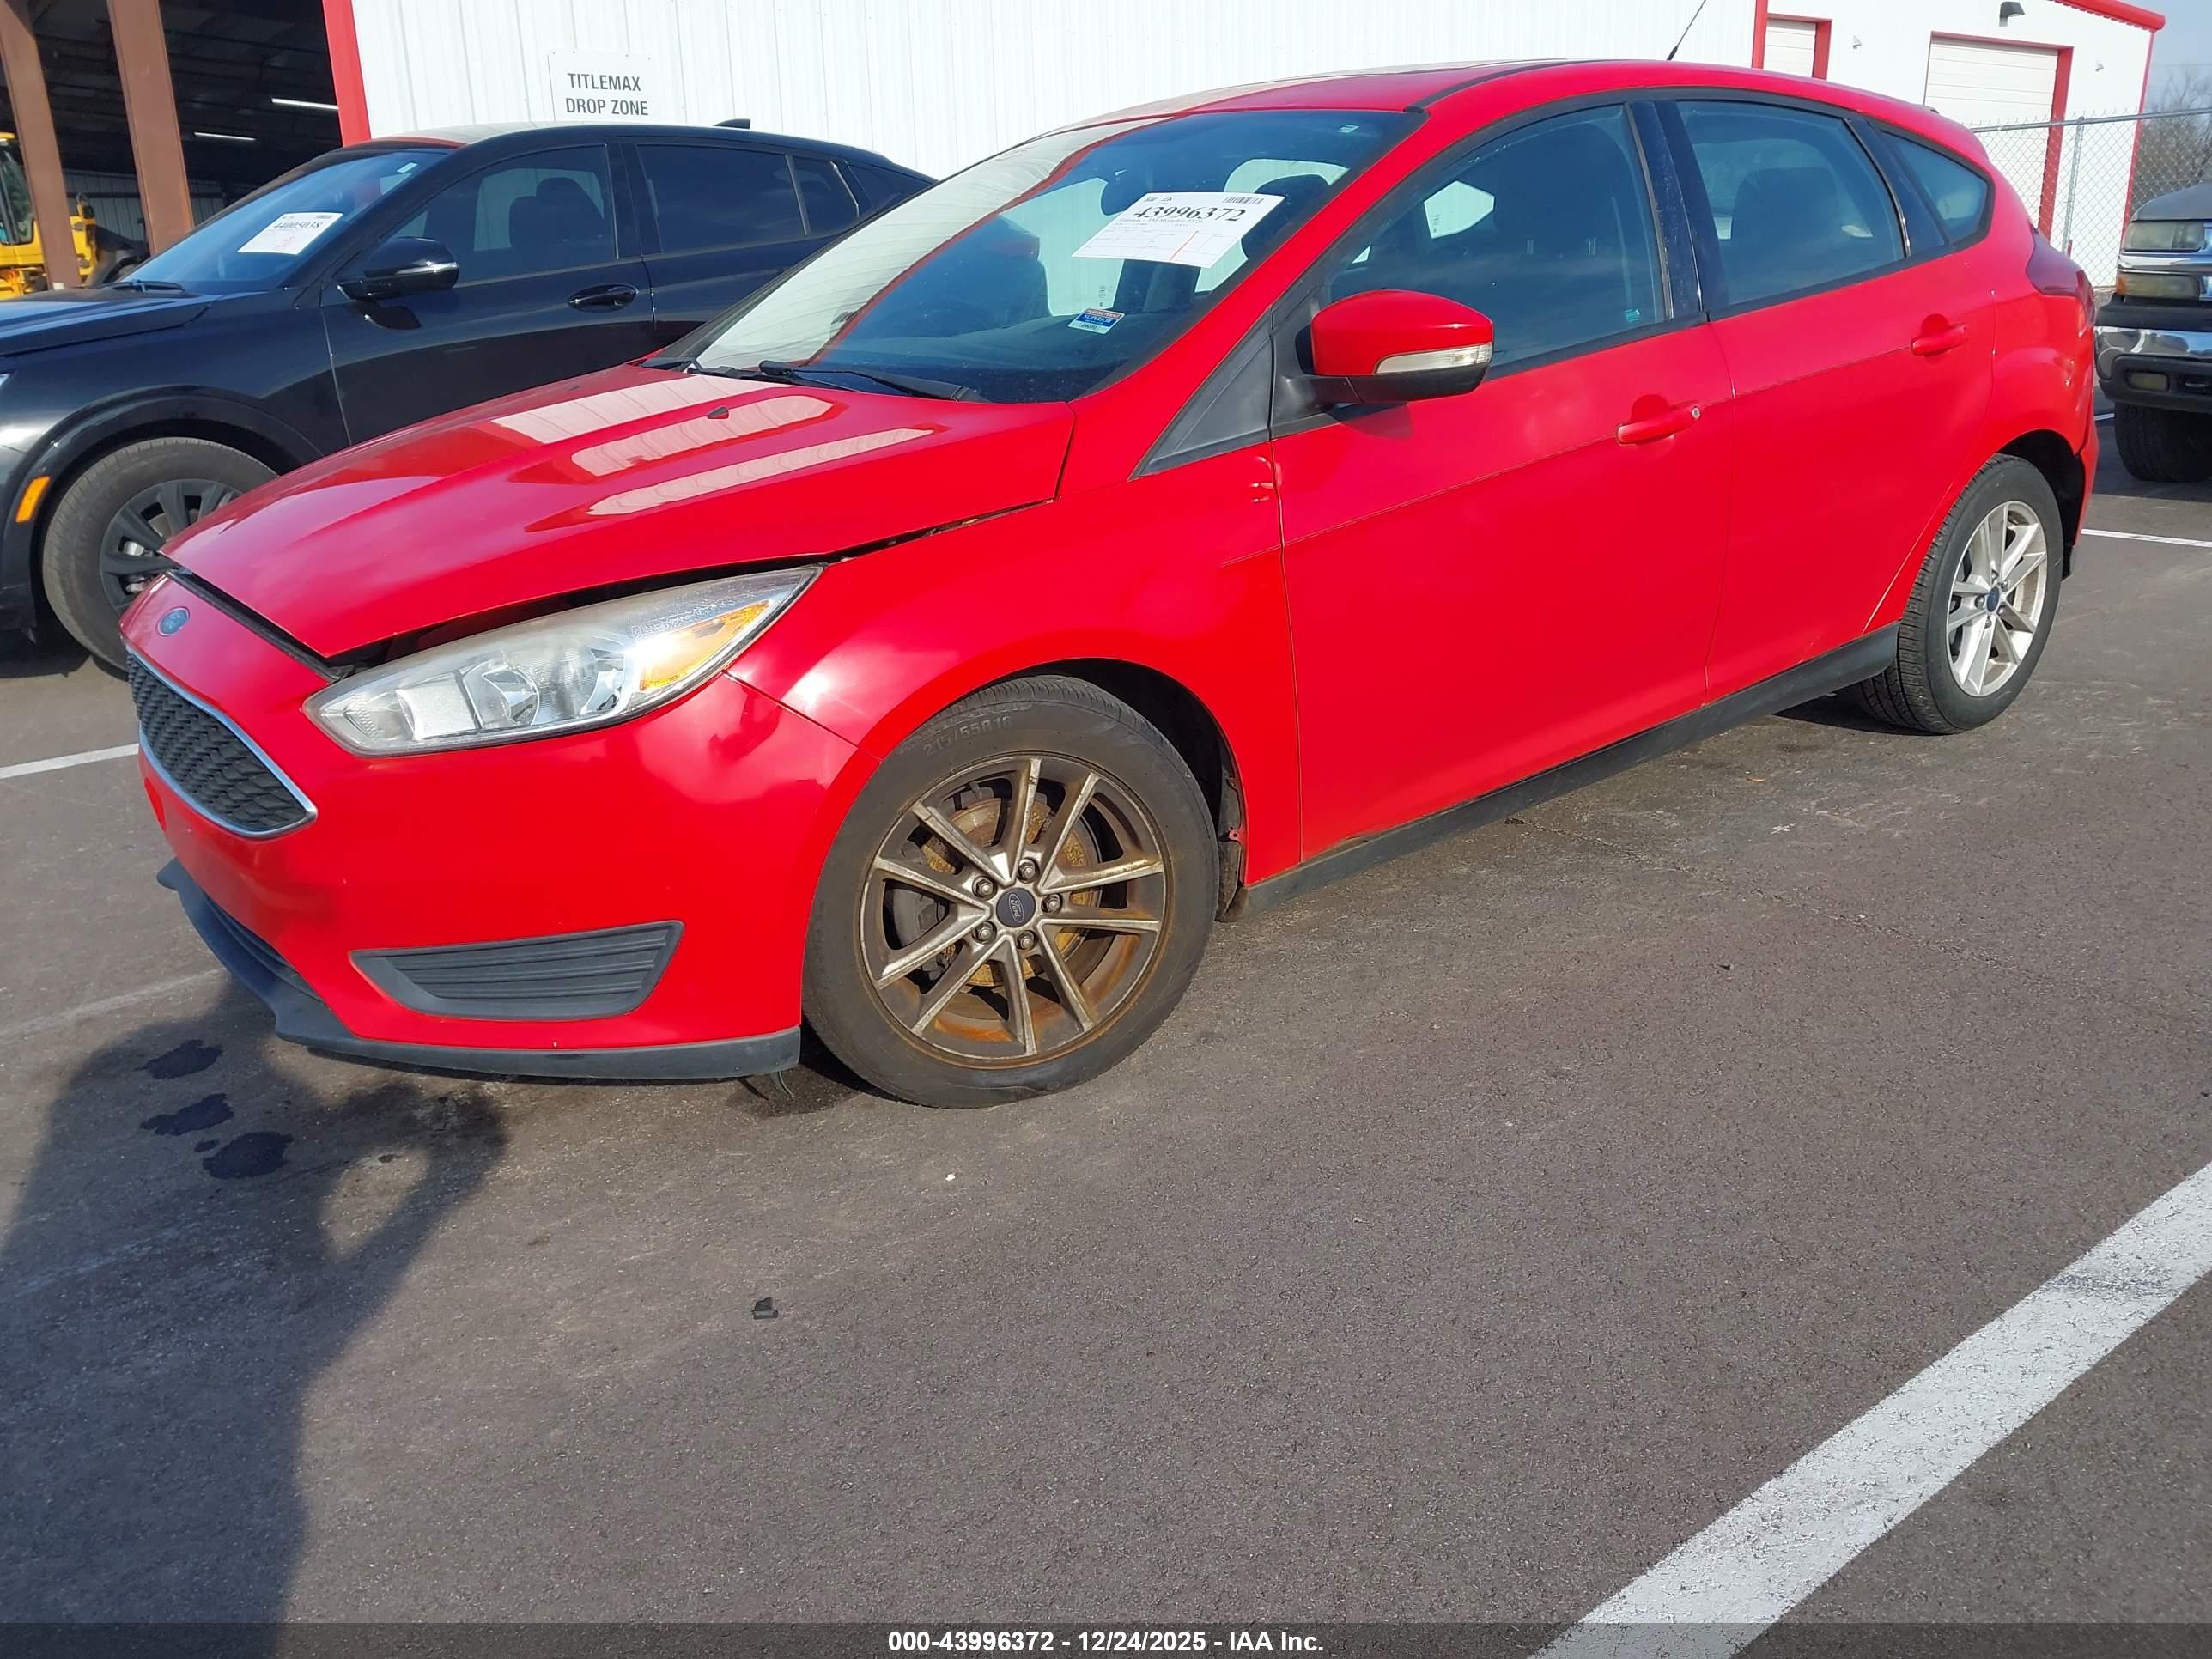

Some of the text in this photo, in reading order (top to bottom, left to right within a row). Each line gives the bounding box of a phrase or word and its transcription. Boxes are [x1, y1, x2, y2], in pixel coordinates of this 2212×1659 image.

[568, 73, 641, 91] TITLEMAX
[566, 98, 647, 115] DROP ZONE
[1133, 206, 1246, 222] 43996372
